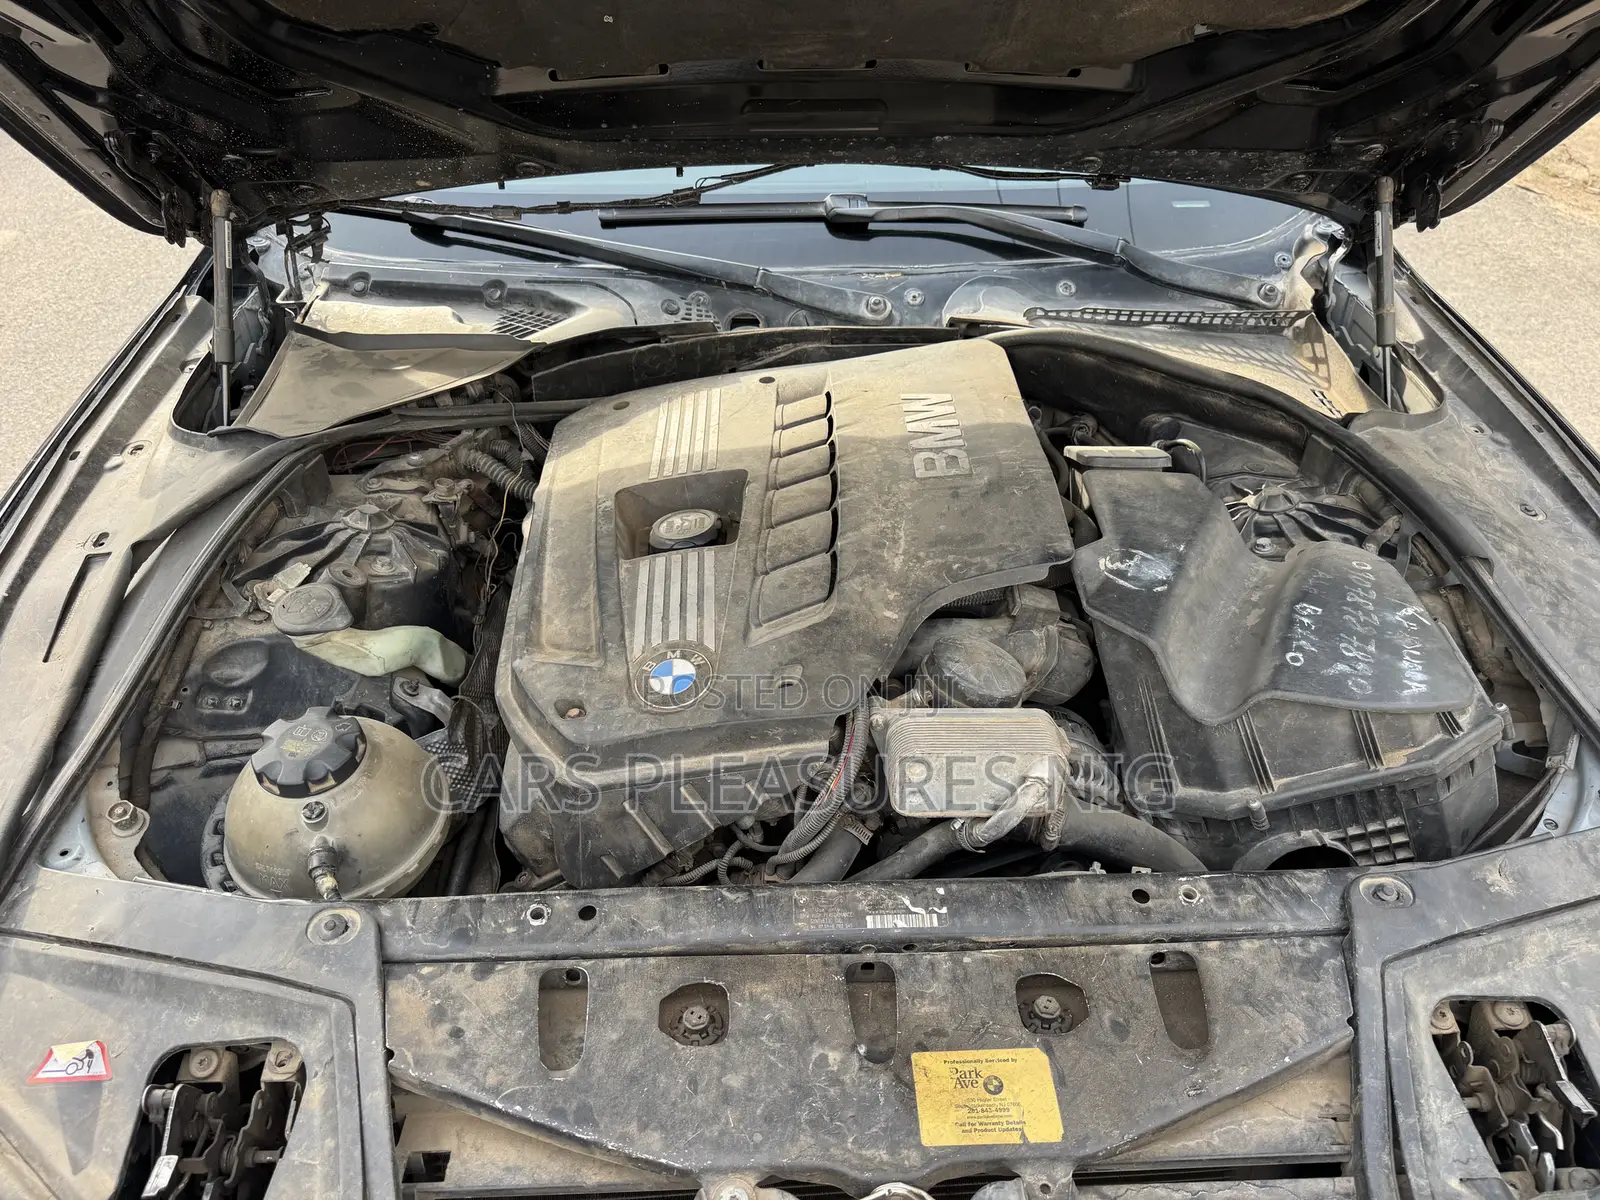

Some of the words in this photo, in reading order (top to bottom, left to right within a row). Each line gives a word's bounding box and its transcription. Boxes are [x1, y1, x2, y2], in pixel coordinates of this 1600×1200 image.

[900, 393, 973, 479] BMW
[642, 650, 706, 672] BMW
[258, 872, 291, 891] MAX
[949, 1067, 984, 1080] Park
[953, 1077, 979, 1089] Ave
